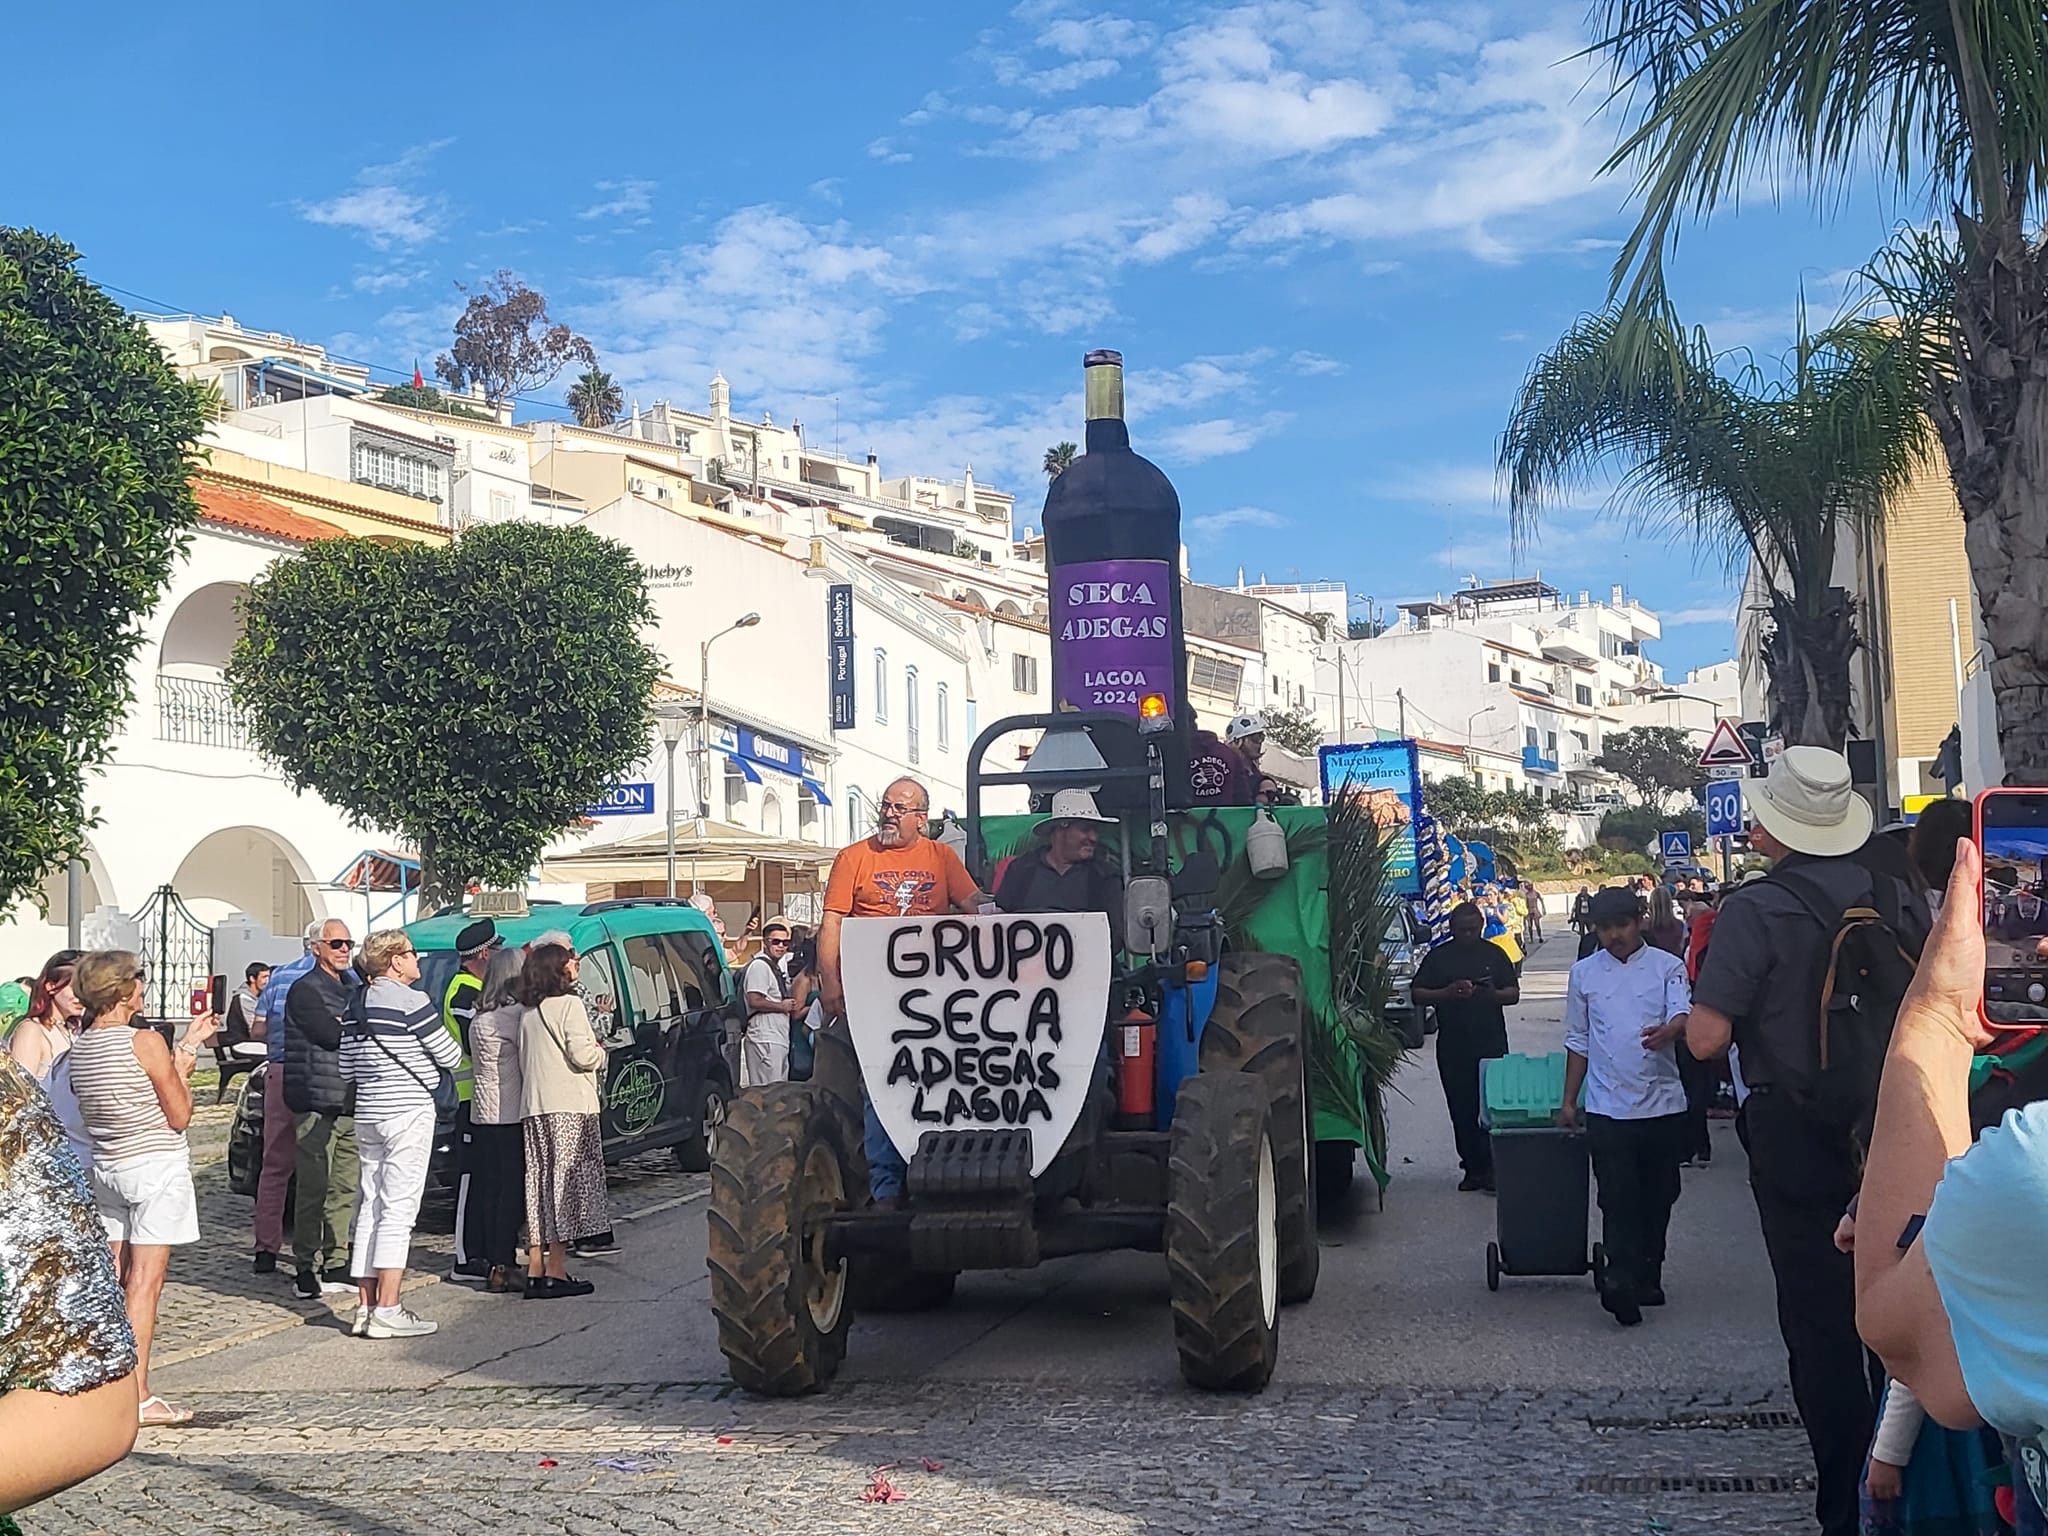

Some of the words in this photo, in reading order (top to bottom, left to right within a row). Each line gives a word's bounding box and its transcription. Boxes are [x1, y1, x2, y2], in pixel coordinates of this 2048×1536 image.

[1067, 582, 1157, 606] SECA
[834, 592, 845, 637] Sotheby's
[1060, 616, 1168, 641] ADEGAS
[837, 646, 848, 681] Portugal
[1084, 670, 1147, 687] LAGOA
[1093, 690, 1138, 704] 2024
[1330, 755, 1385, 768] Marchas
[1710, 793, 1738, 823] 30
[886, 919, 1074, 983] GRUPO
[891, 987, 1063, 1047] SECA
[887, 1045, 1061, 1091] ADEGAS
[911, 1086, 1053, 1126] LAGOA
